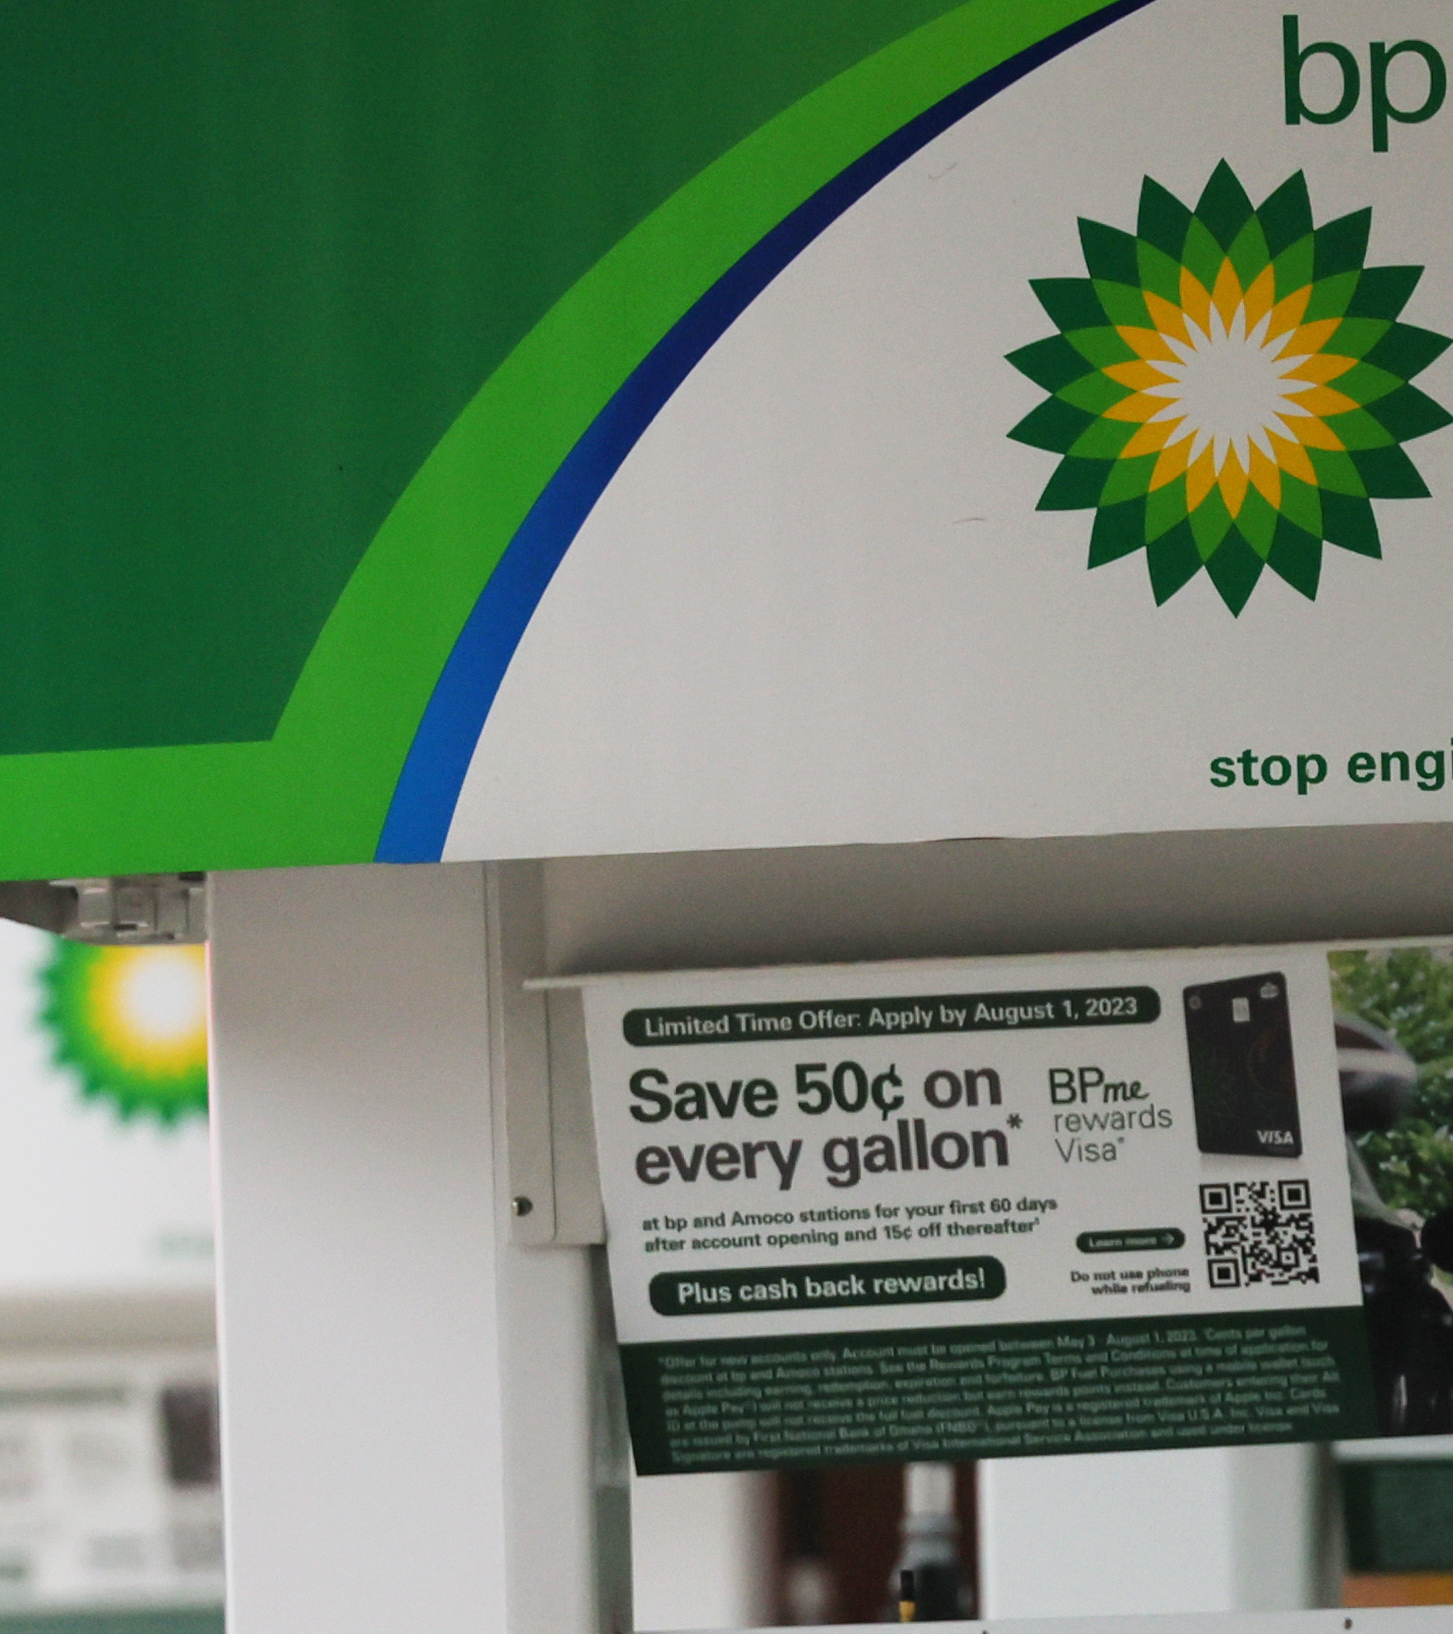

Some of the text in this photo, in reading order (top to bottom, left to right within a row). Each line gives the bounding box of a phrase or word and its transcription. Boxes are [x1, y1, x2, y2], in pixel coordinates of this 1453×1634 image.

[1281, 13, 1448, 153] bp
[1207, 747, 1329, 796] stop
[644, 996, 1139, 1037] Limited Time Offer: Apply by August 1, 2023
[628, 1060, 1003, 1124] Save 50¢ on
[1048, 1066, 1150, 1106] BPme
[1053, 1103, 1174, 1133] rewards
[1256, 1129, 1295, 1145] VISA
[635, 1138, 803, 1191] every
[642, 1196, 1058, 1233] at bp and Amoco stations for your first 60 days
[644, 1237, 686, 1252] after
[691, 1233, 761, 1251] account
[766, 1229, 839, 1249] opening
[844, 1226, 877, 1243] and
[918, 1222, 942, 1238] off
[677, 1267, 986, 1305] Plus cash back rewards!
[1070, 1270, 1090, 1282] Do
[1119, 1270, 1144, 1280] use
[1146, 1267, 1190, 1281] phone
[1090, 1282, 1128, 1295] while
